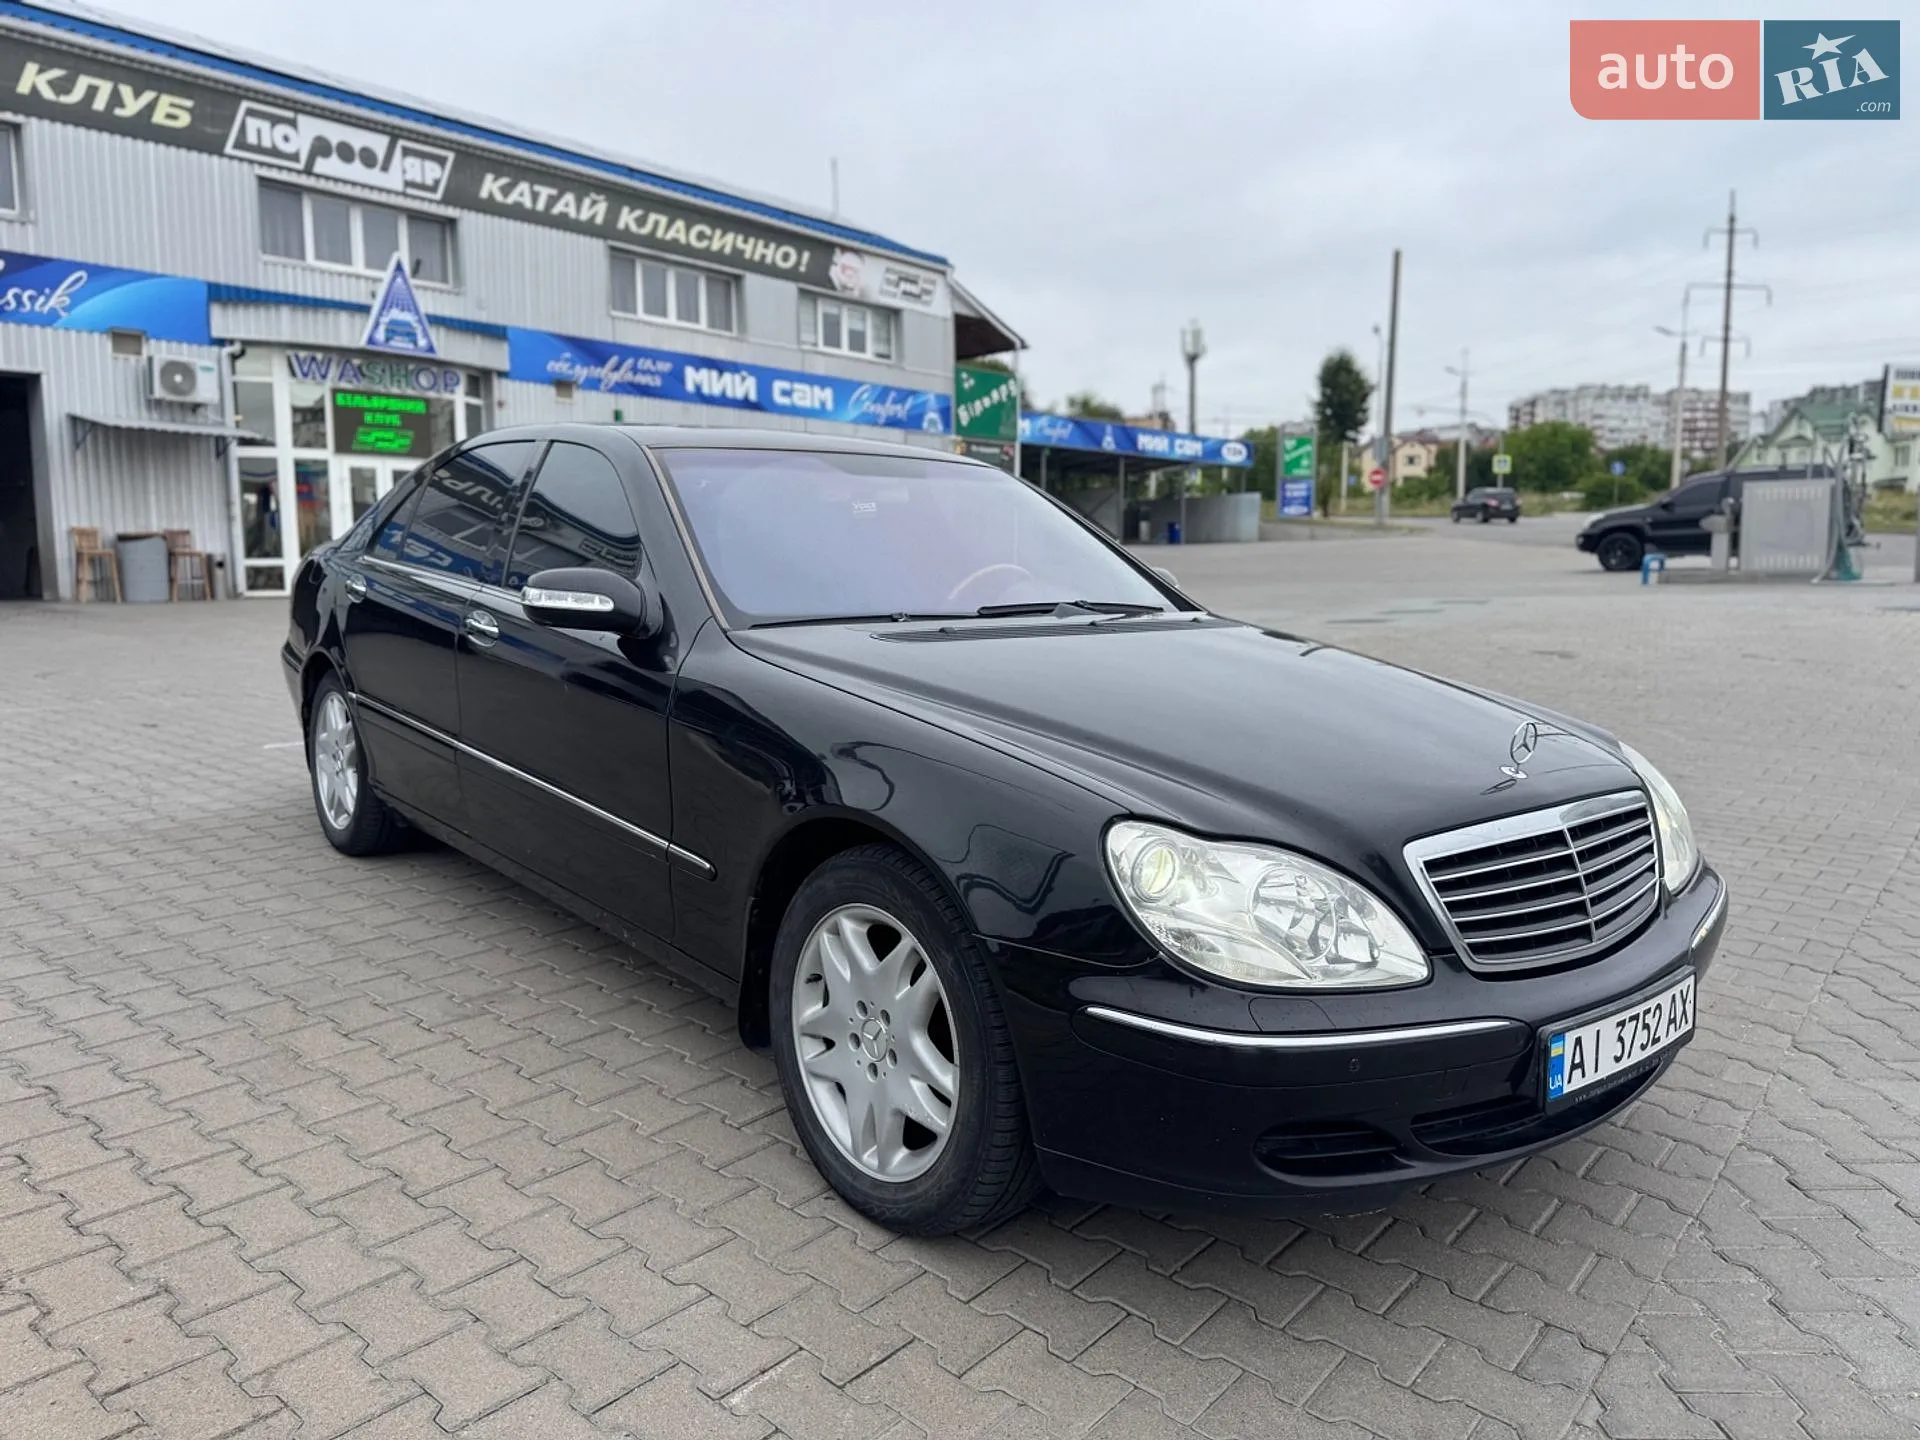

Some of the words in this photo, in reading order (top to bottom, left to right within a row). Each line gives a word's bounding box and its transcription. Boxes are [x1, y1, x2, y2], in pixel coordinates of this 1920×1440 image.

[15, 61, 195, 129] КЛУБ
[478, 172, 609, 225] КАТАЙ
[616, 206, 812, 273] КЛАСИЧНО!
[0, 270, 88, 317] ssik
[293, 352, 461, 393] WASHOP
[1567, 1029, 1600, 1084] AI
[1613, 1003, 1662, 1063] 3752
[1666, 984, 1690, 1039] AX
[1549, 1074, 1563, 1090] UA
